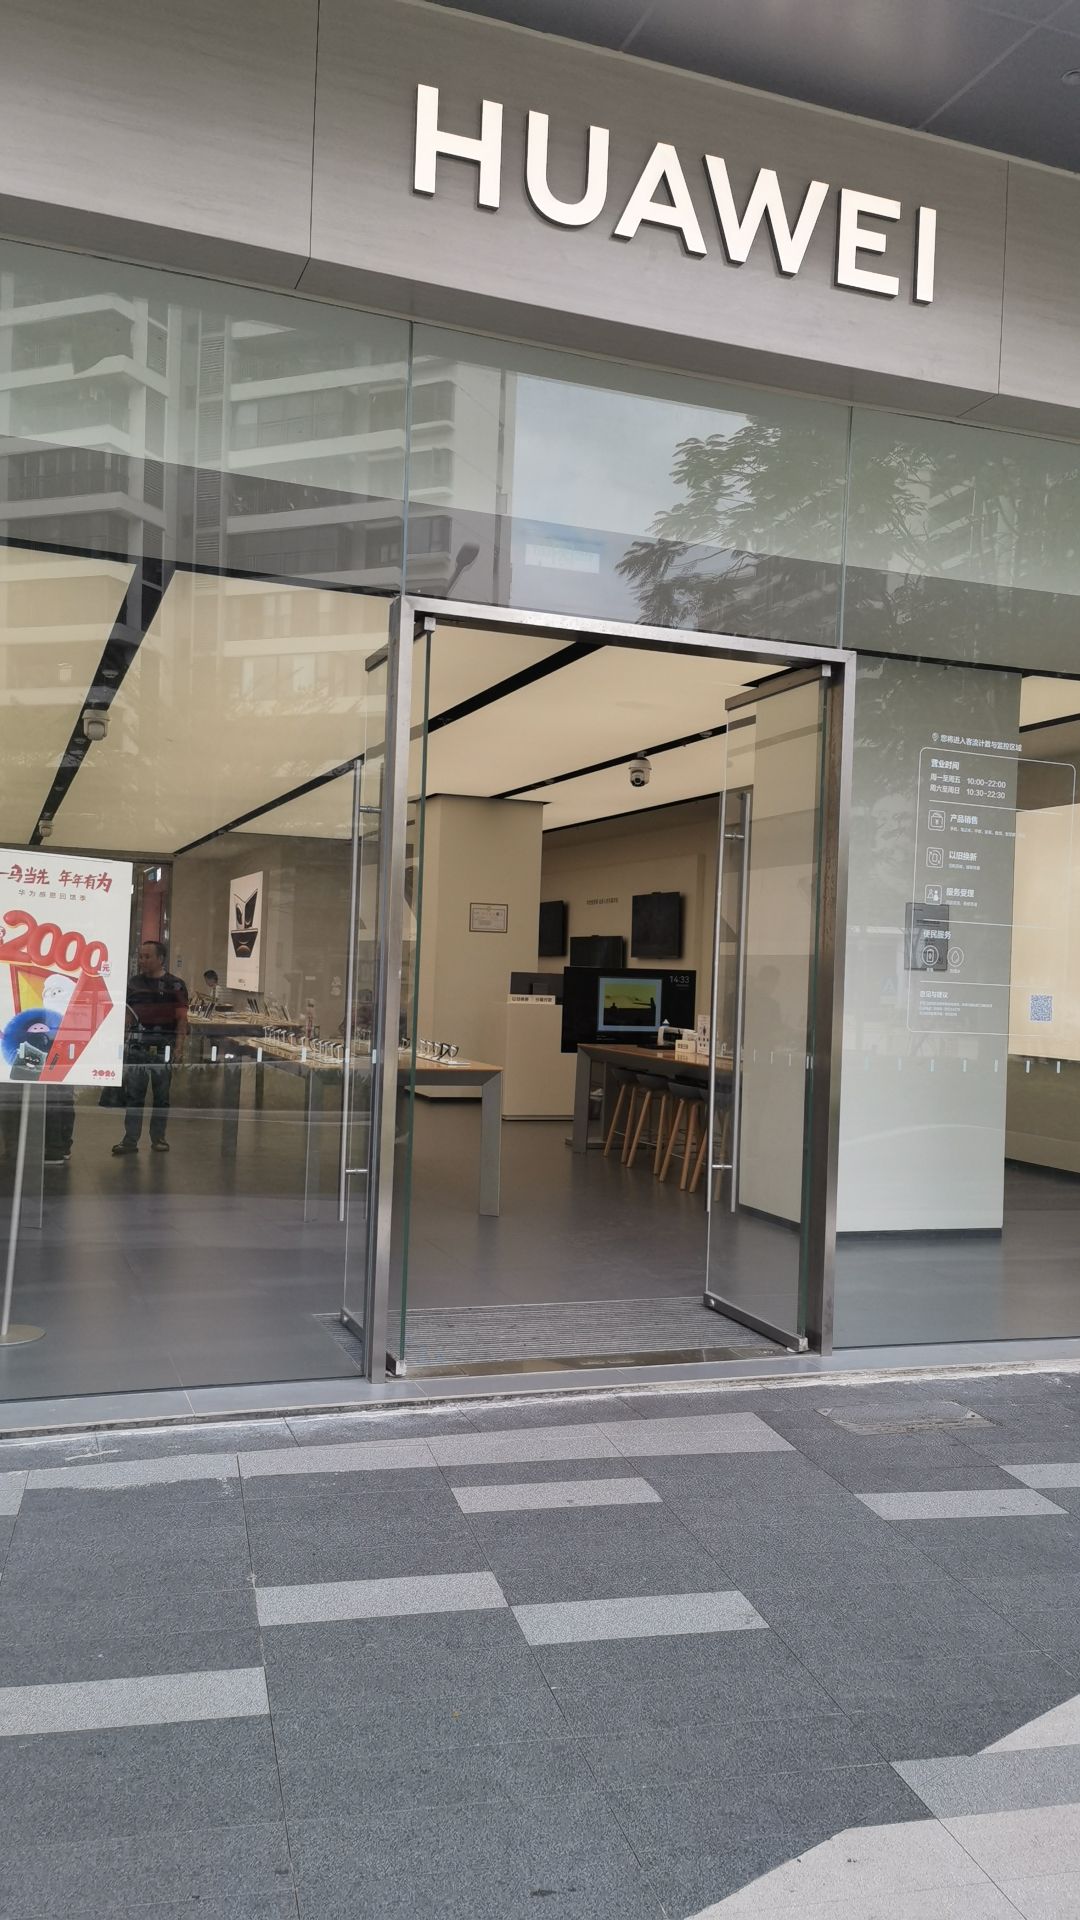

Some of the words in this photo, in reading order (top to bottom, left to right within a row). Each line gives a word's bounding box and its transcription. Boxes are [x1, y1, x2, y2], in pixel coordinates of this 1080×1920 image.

[413, 84, 937, 304] HUAWEI
[930, 758, 960, 771] 营业时间
[930, 773, 961, 784] 周一至周五
[967, 778, 1007, 789] 10:00-22:00
[929, 783, 960, 795] 周六至周日
[966, 788, 1006, 799] 10:30-22:30
[950, 813, 978, 825] 产品销售
[949, 850, 977, 862] 以旧换新
[0, 864, 50, 885] 一马当先
[58, 869, 113, 893] 年年有为
[946, 887, 975, 898] 服务受理
[923, 929, 952, 940] 便民服务
[92, 1069, 115, 1077] 2026
